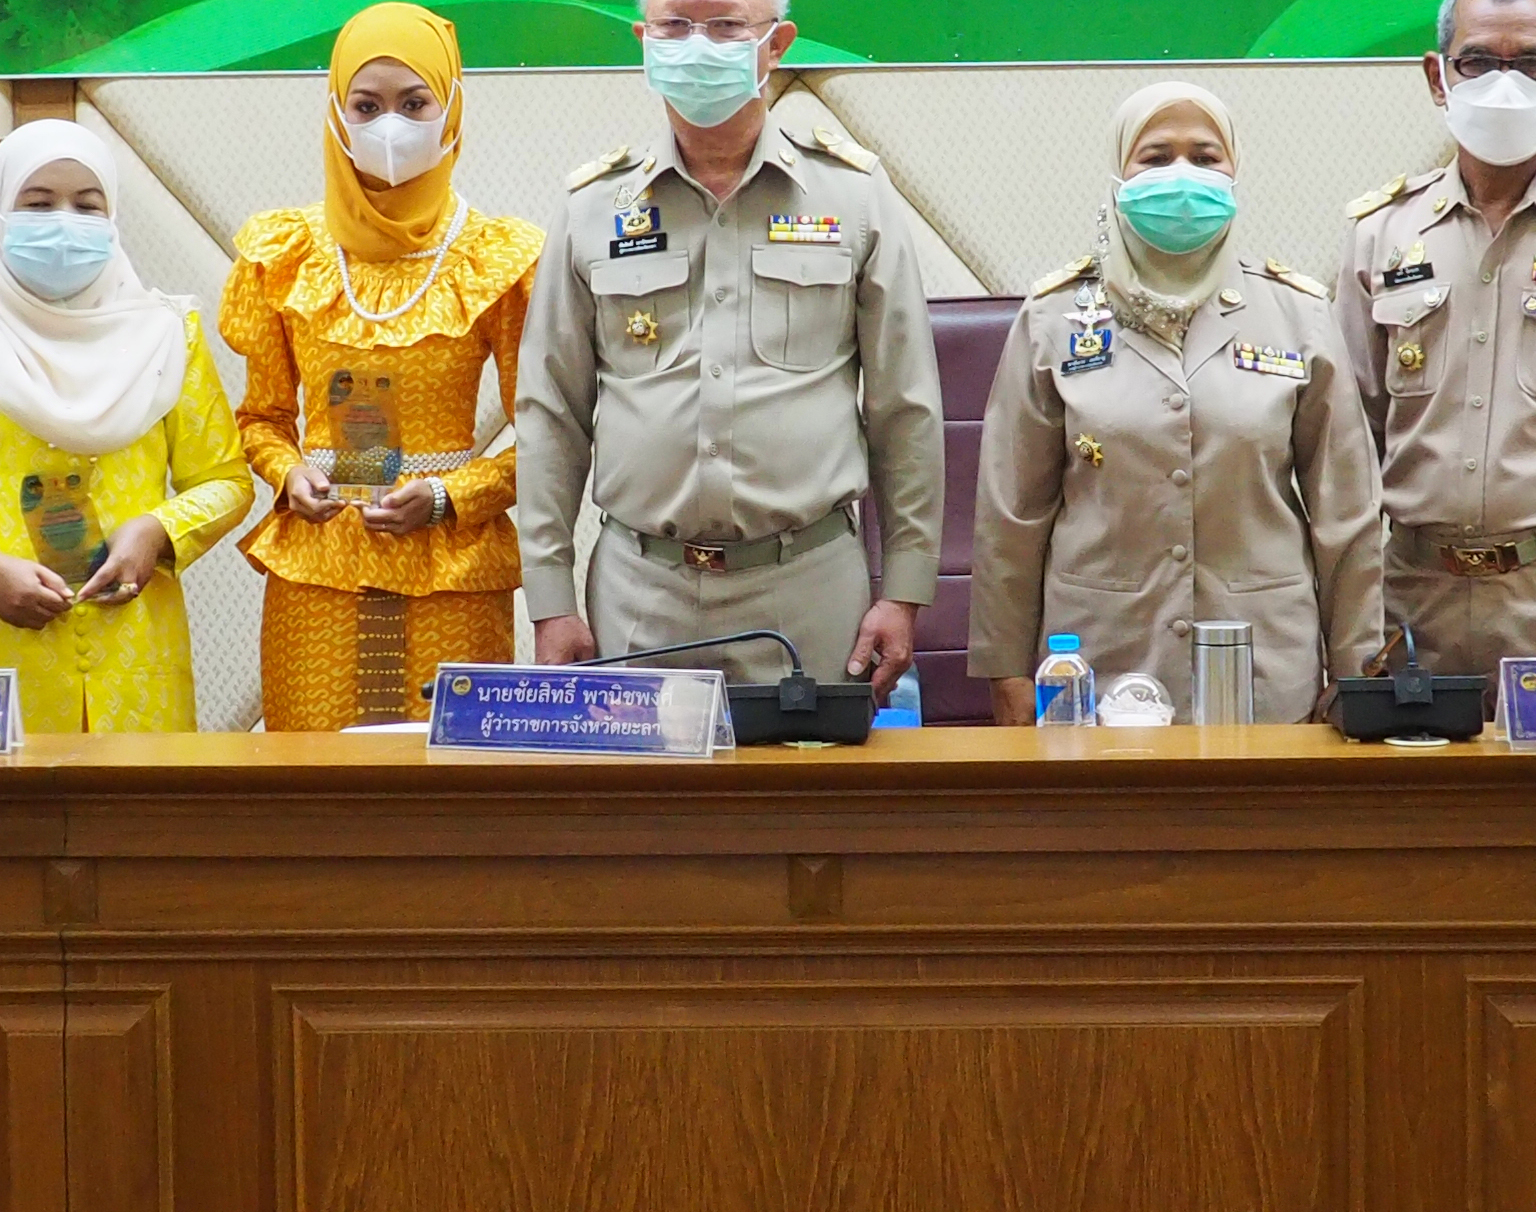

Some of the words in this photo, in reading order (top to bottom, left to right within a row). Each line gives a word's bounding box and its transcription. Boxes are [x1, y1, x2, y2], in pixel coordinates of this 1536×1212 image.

[477, 676, 579, 704] นายชัยสิทธิ์
[480, 710, 661, 738] ผู้ว่าราชการจังหวัดยะลา
